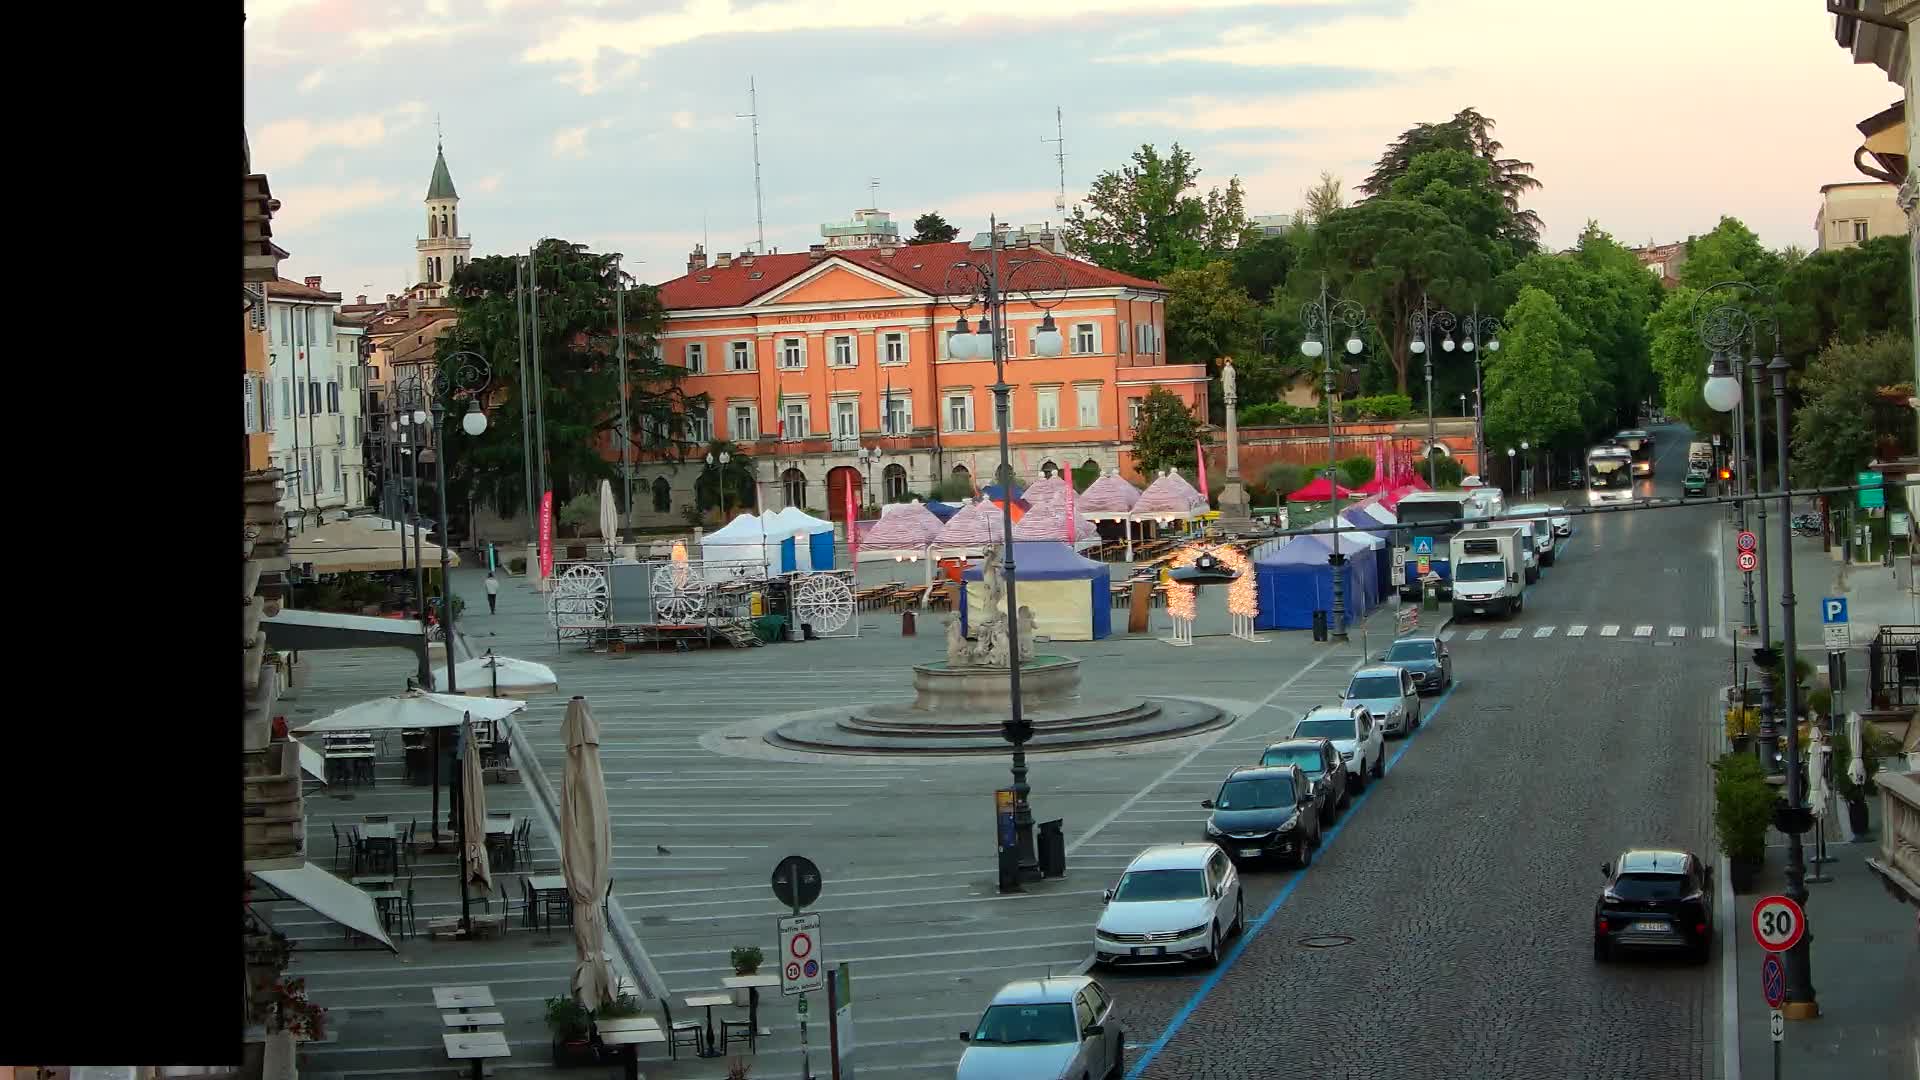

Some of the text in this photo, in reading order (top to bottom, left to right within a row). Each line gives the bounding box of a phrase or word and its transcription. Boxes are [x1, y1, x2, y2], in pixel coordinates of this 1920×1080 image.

[1742, 556, 1753, 566] 20
[1826, 601, 1842, 621] P
[1762, 910, 1791, 937] 30
[789, 967, 798, 977] 20
